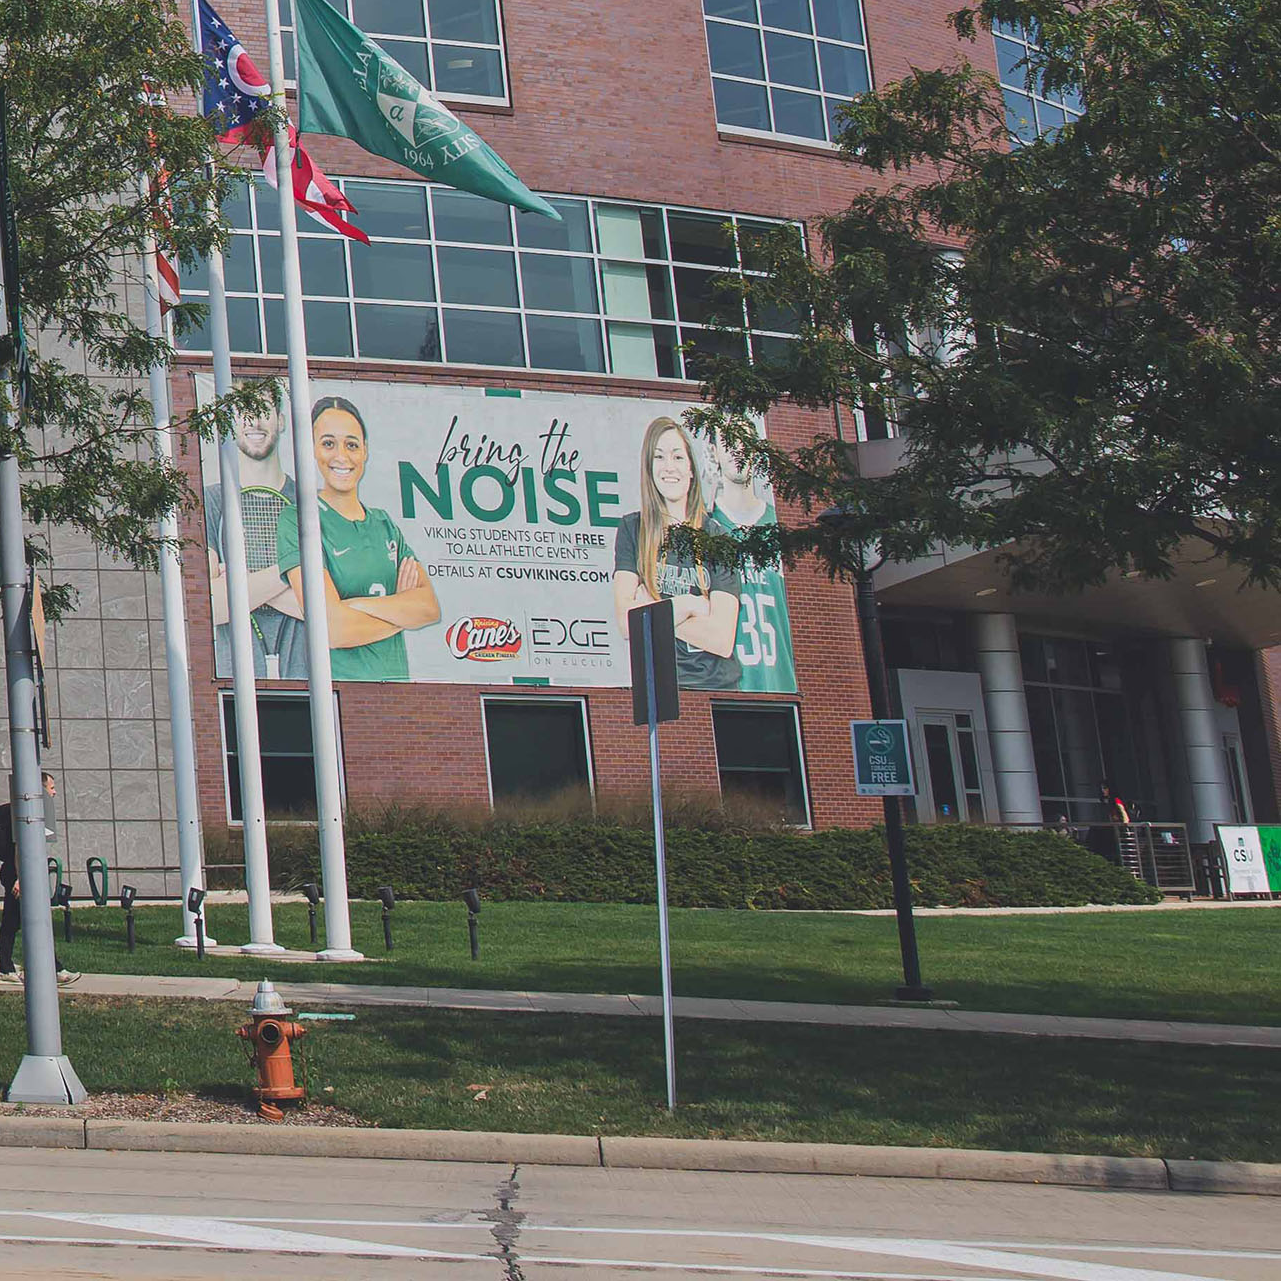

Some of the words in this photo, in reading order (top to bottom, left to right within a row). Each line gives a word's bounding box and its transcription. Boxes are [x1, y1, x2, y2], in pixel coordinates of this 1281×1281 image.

[403, 147, 434, 170] 1964
[435, 415, 529, 487] bring
[539, 418, 582, 478] the
[398, 461, 621, 527] NOISE
[423, 527, 466, 540] VIKING
[469, 528, 530, 542] STUDENTS
[534, 531, 555, 543] GET
[559, 532, 572, 544] IN
[575, 533, 605, 546] FREE
[446, 542, 463, 555] TO
[465, 544, 487, 556] ALL
[489, 544, 544, 558] ATHLETIC
[547, 546, 589, 560] EVENTS
[427, 565, 475, 578] DETAILS
[478, 566, 492, 578] AT
[496, 567, 609, 583] CSUVIKINGS.COM
[449, 616, 521, 659] Cane's
[531, 618, 610, 648] EDGE
[736, 593, 776, 667] 35
[534, 656, 552, 666] ON
[563, 657, 613, 668] EUCLID
[869, 755, 887, 765] CSU
[871, 772, 898, 783] FREE
[1233, 849, 1254, 862] CSU
